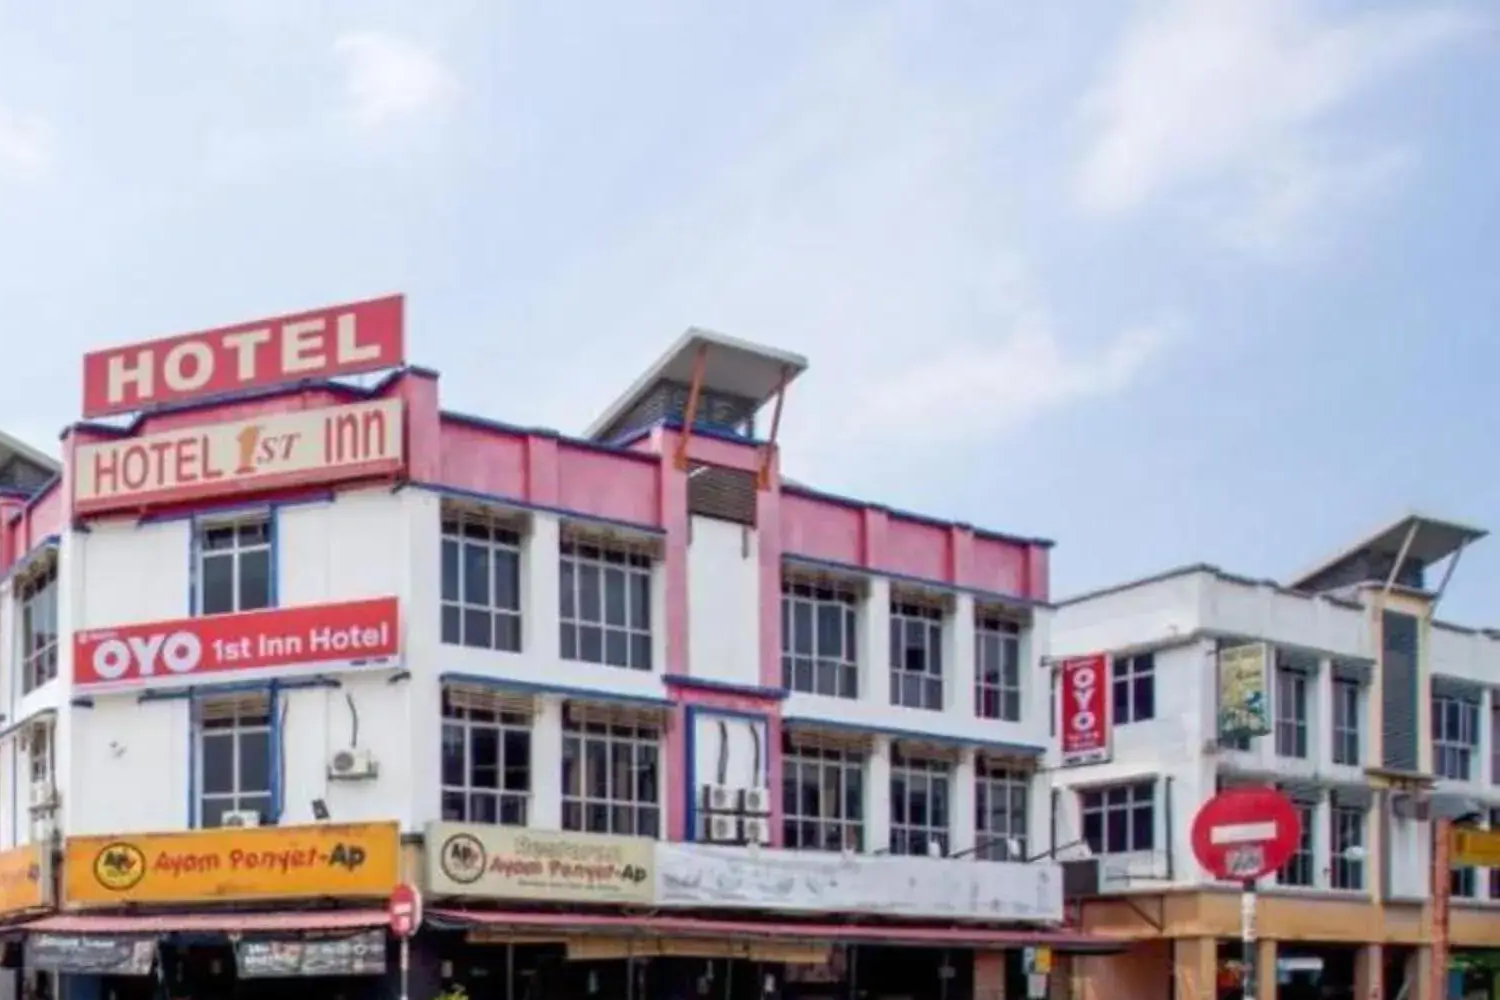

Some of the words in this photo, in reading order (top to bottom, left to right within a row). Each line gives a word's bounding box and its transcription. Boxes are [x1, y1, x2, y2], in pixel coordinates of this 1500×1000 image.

[108, 313, 381, 404] HOTEL
[94, 434, 222, 495] HOTEL
[92, 631, 201, 678] OYO
[212, 639, 249, 662] 1st
[259, 633, 302, 657] Inn
[309, 621, 389, 651] Hotel
[1071, 668, 1096, 732] OYO
[153, 850, 221, 878] Ayam
